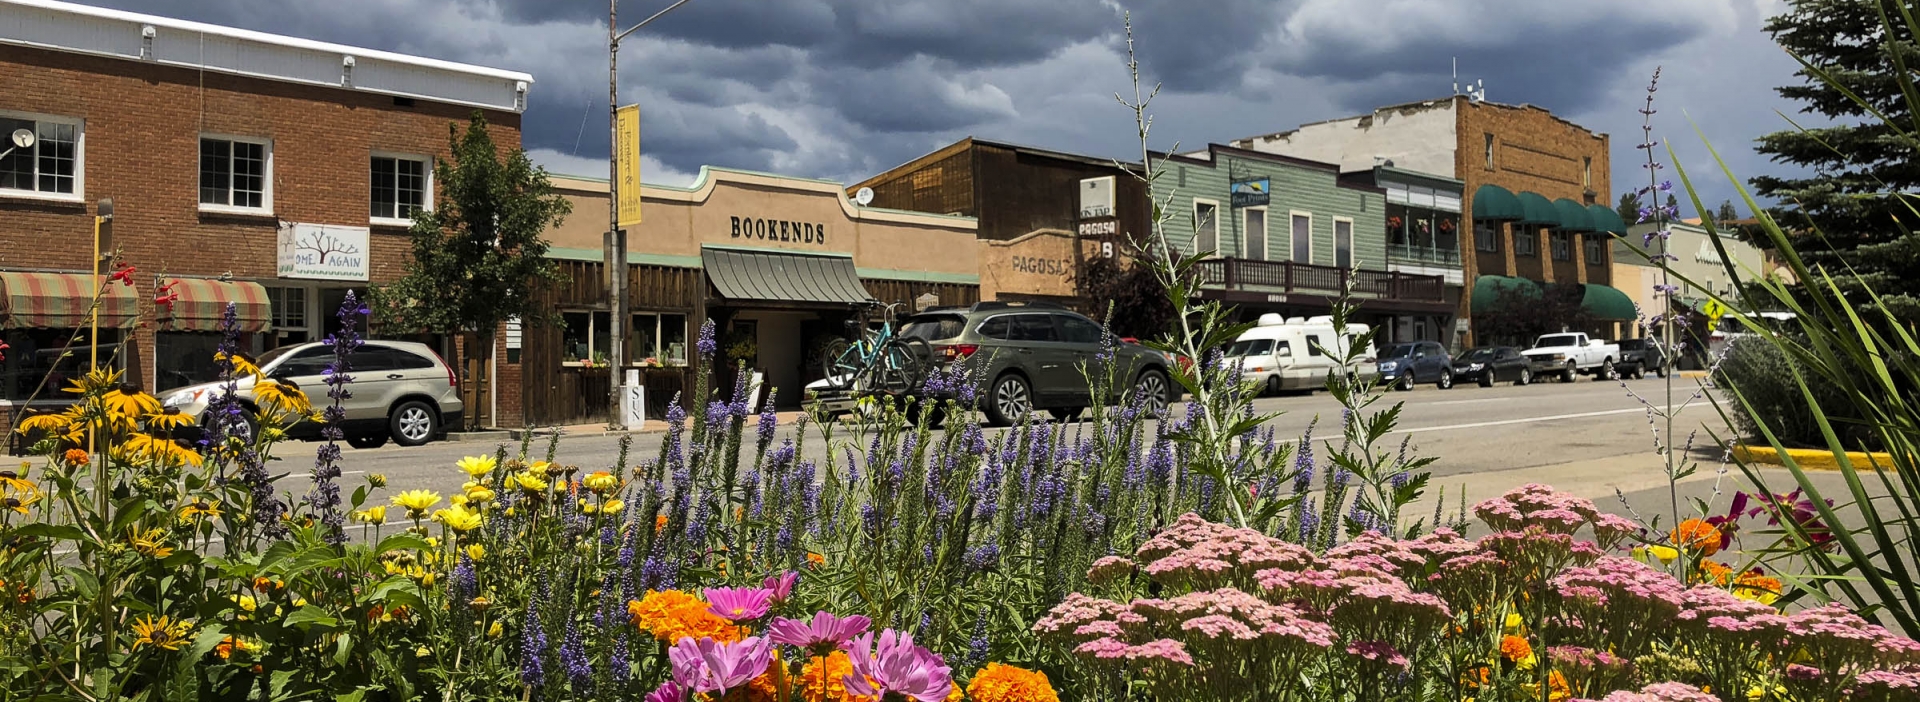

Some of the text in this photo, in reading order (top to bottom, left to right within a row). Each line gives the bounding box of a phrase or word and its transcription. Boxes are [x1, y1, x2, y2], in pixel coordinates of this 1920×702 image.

[1094, 207, 1110, 217] TAP
[730, 216, 825, 245] BOOKENDS
[1079, 221, 1115, 236] PAGOSA
[296, 253, 316, 266] OME
[328, 255, 361, 268] AGAIN
[1012, 255, 1063, 276] PAGOSA
[632, 386, 640, 421] SUN
